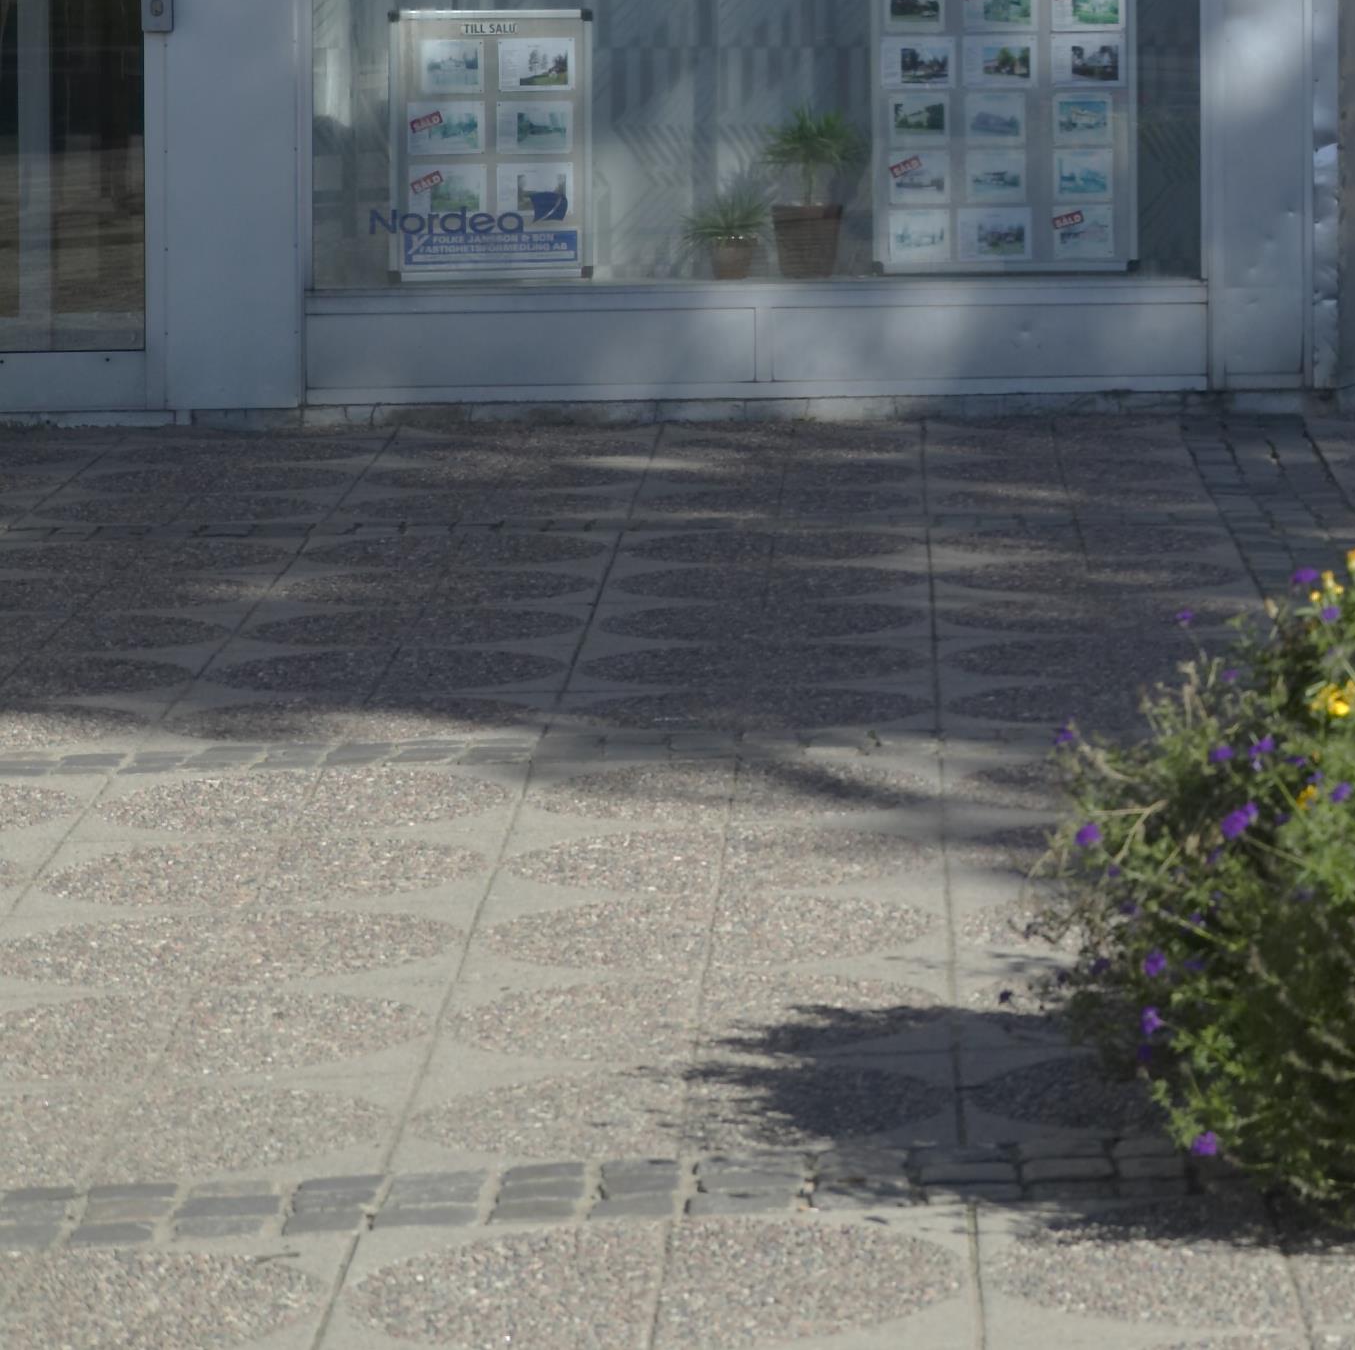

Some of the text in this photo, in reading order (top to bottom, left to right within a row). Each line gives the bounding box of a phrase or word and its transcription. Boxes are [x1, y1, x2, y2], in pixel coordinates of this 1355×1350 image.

[464, 22, 516, 35] TILL SALU
[412, 172, 441, 193] SÅLD
[369, 206, 524, 235] Nordea
